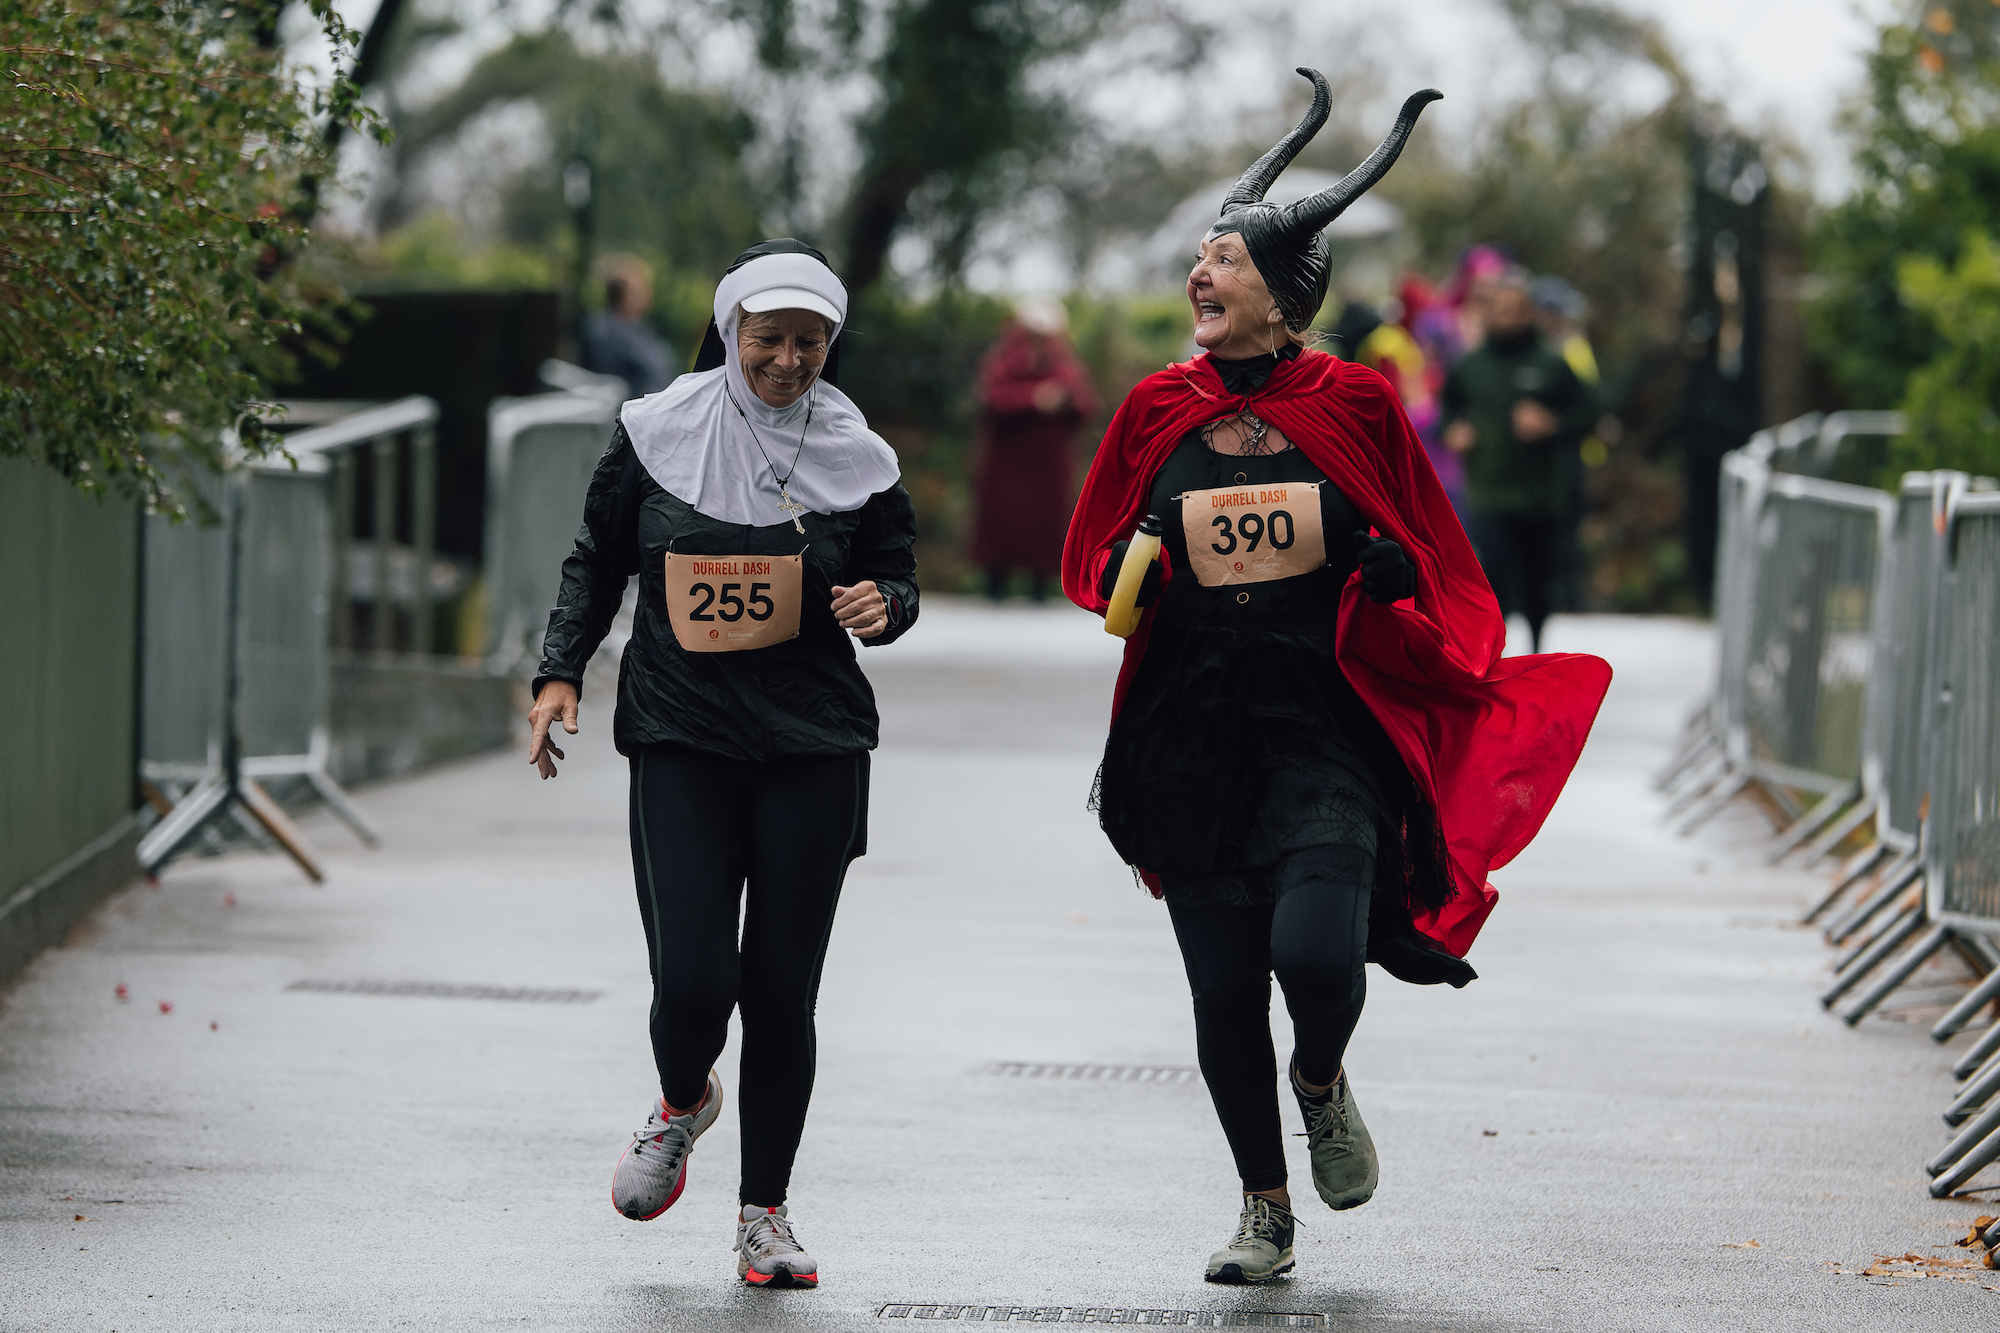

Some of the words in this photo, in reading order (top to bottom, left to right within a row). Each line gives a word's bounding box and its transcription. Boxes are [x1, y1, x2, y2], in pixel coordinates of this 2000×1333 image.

[1211, 492, 1257, 508] DURRELL
[1260, 489, 1287, 504] DASH
[1211, 510, 1294, 555] 390
[693, 562, 739, 575] DURRELL
[743, 562, 770, 575] DASH
[689, 582, 774, 622] 255
